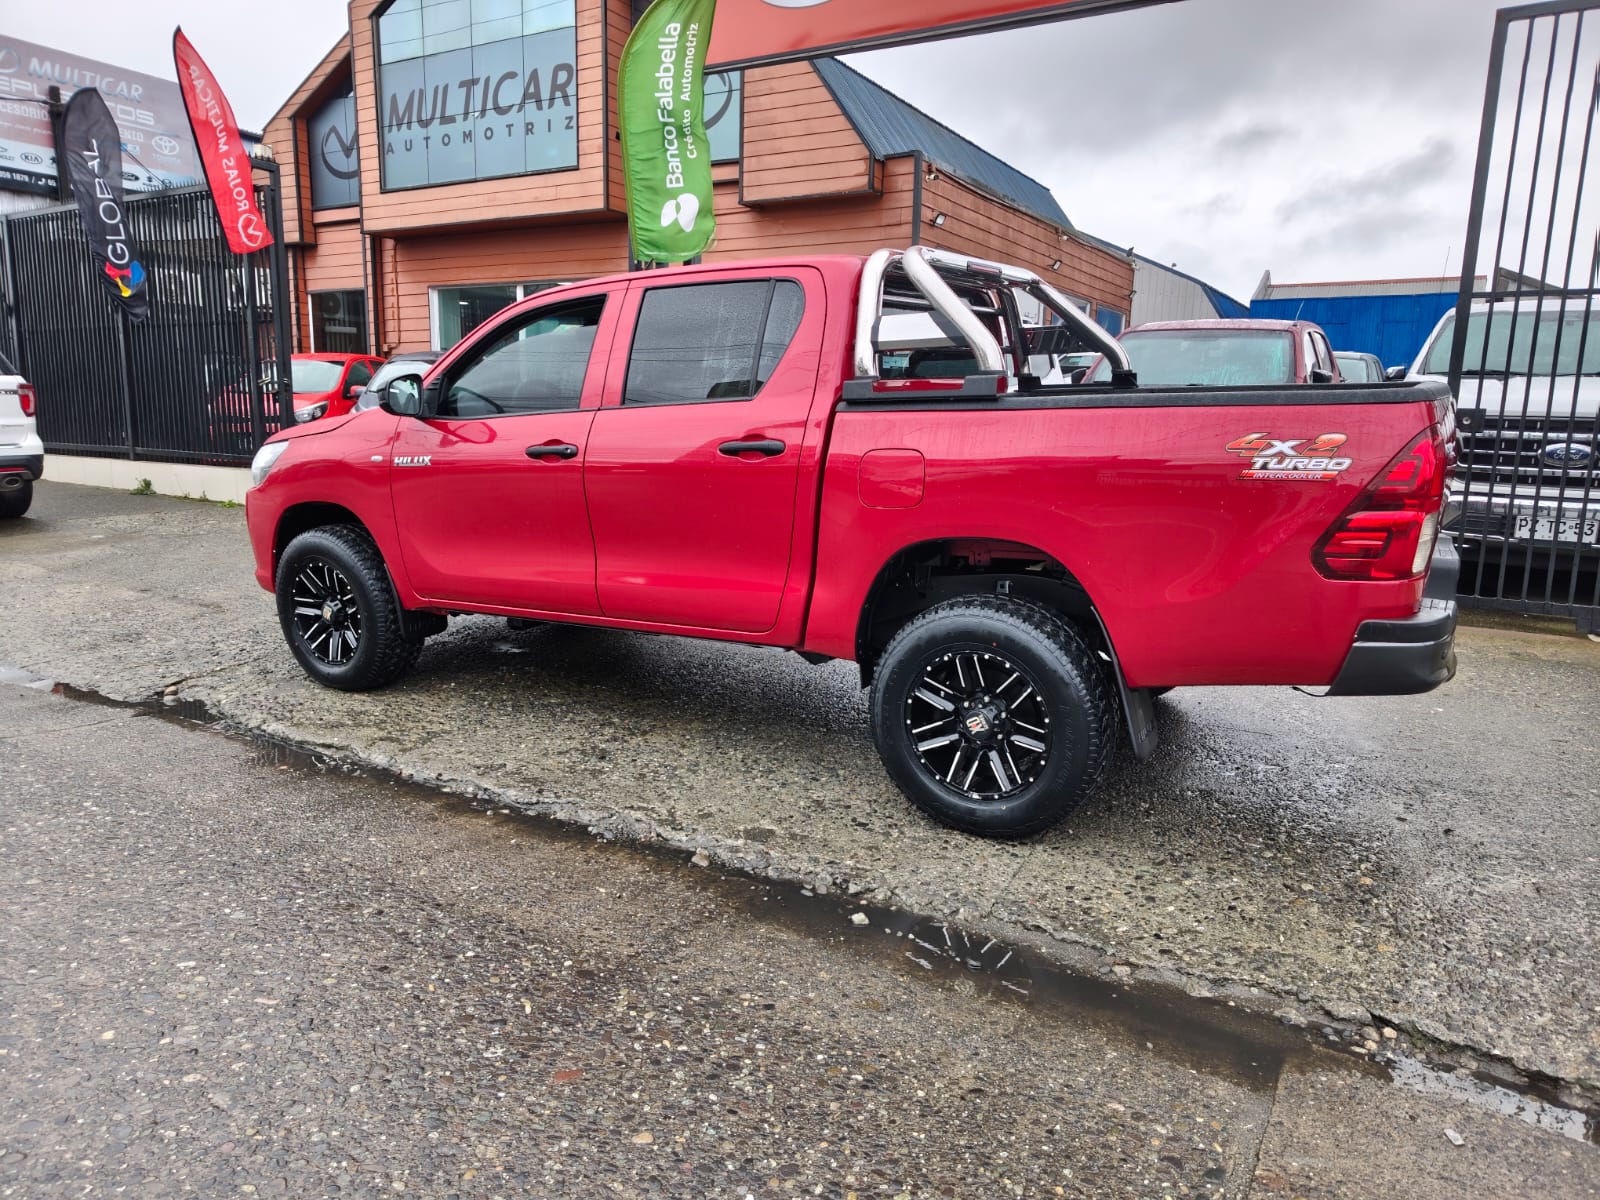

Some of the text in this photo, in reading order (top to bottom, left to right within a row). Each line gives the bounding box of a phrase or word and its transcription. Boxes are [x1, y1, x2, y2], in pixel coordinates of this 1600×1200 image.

[28, 56, 143, 101] MULTICAR
[387, 62, 574, 134] MULTICAR
[655, 22, 684, 188] Banco Falabella
[680, 22, 699, 159] Crédito Automotriz
[385, 116, 574, 155] AUTOMOTRIZ
[83, 138, 130, 264] GLOBAL
[393, 455, 432, 467] HILUX
[1250, 457, 1353, 471] TURBO
